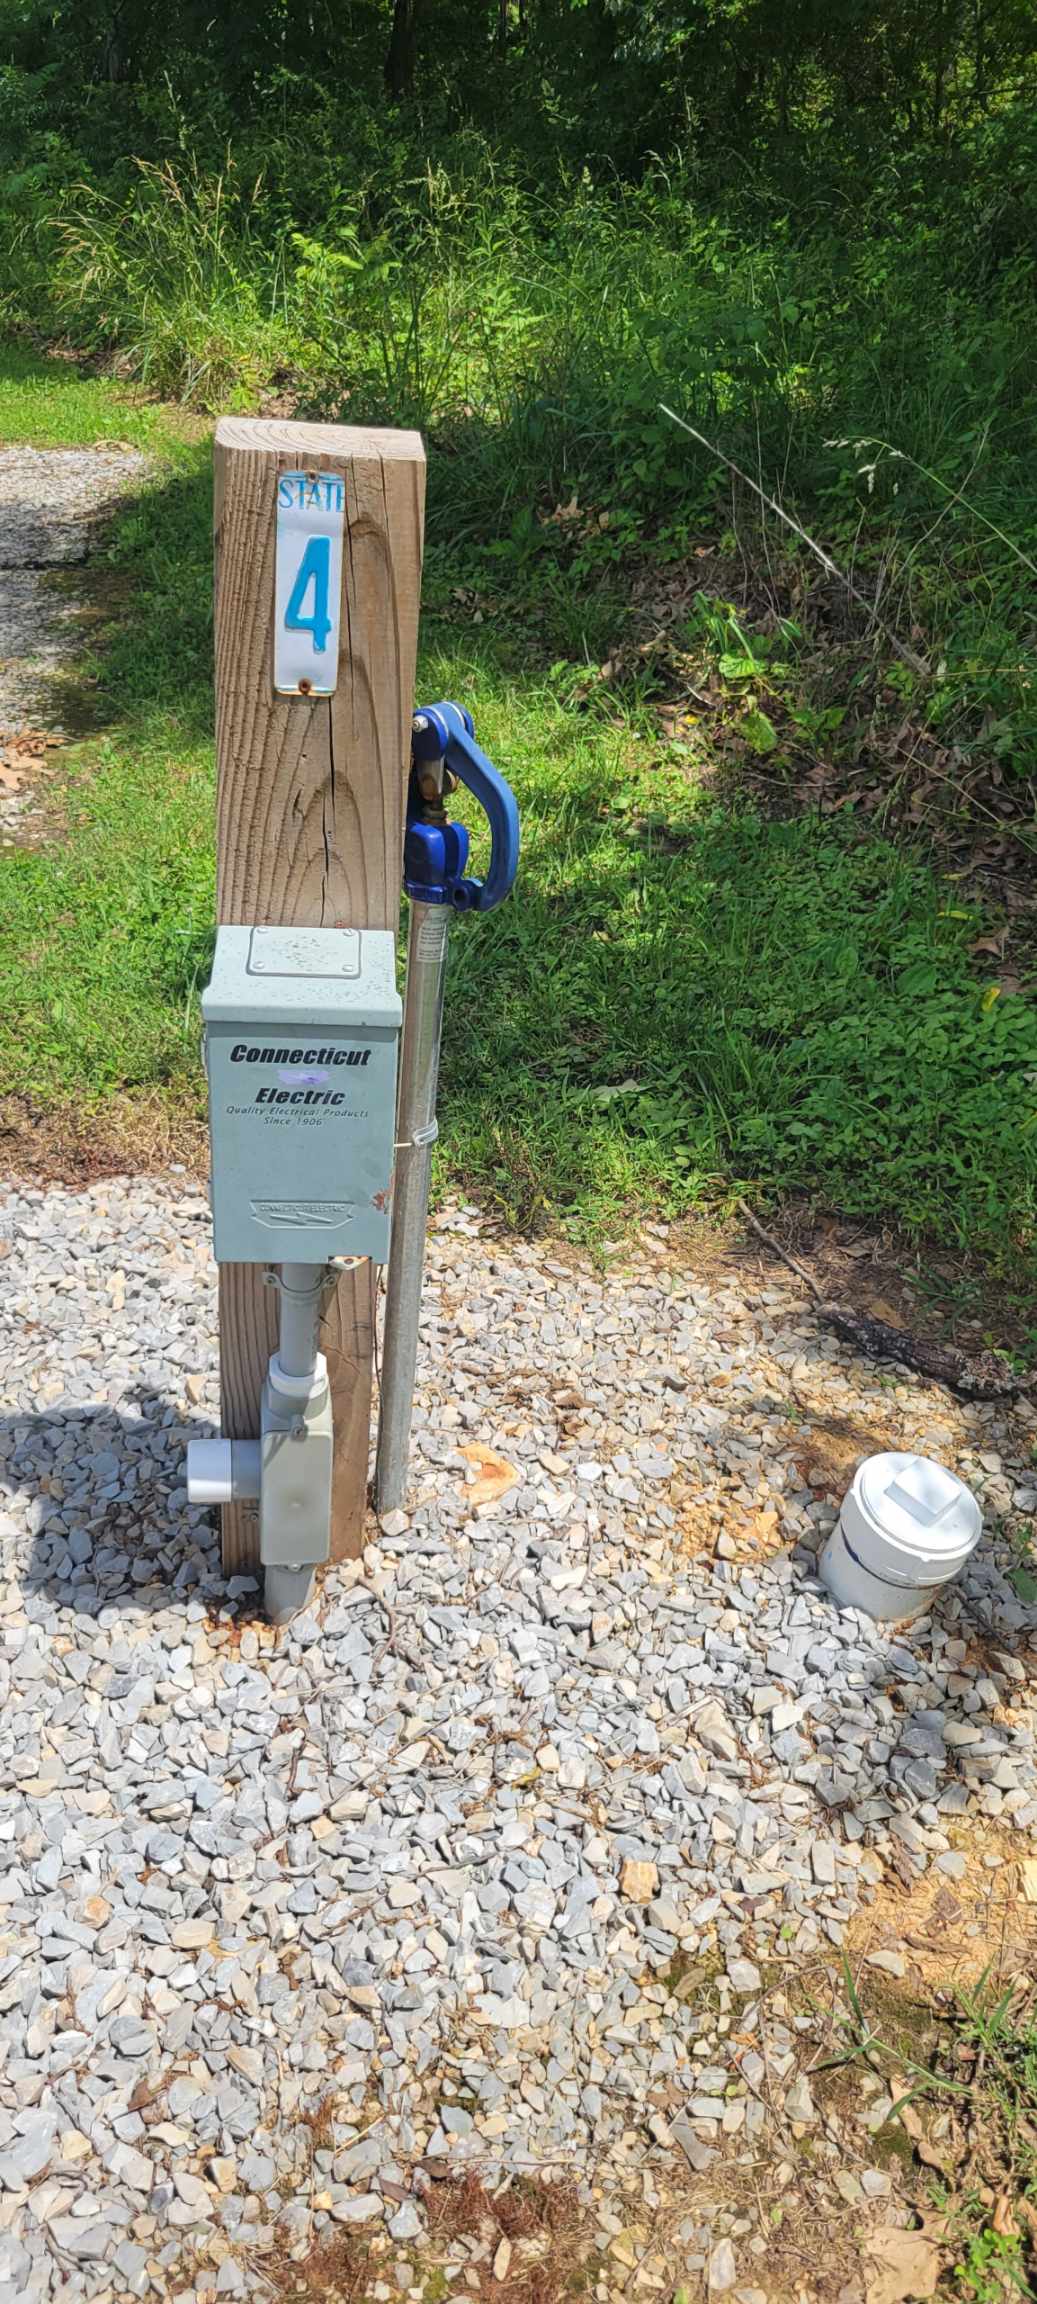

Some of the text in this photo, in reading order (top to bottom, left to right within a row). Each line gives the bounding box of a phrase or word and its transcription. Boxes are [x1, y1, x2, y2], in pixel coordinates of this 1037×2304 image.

[285, 535, 332, 654] 4
[230, 1044, 372, 1066] Connecticut
[255, 1087, 346, 1106] Electric
[226, 1105, 369, 1119] Quality Electrical Products
[264, 1116, 323, 1127] Since 1906
